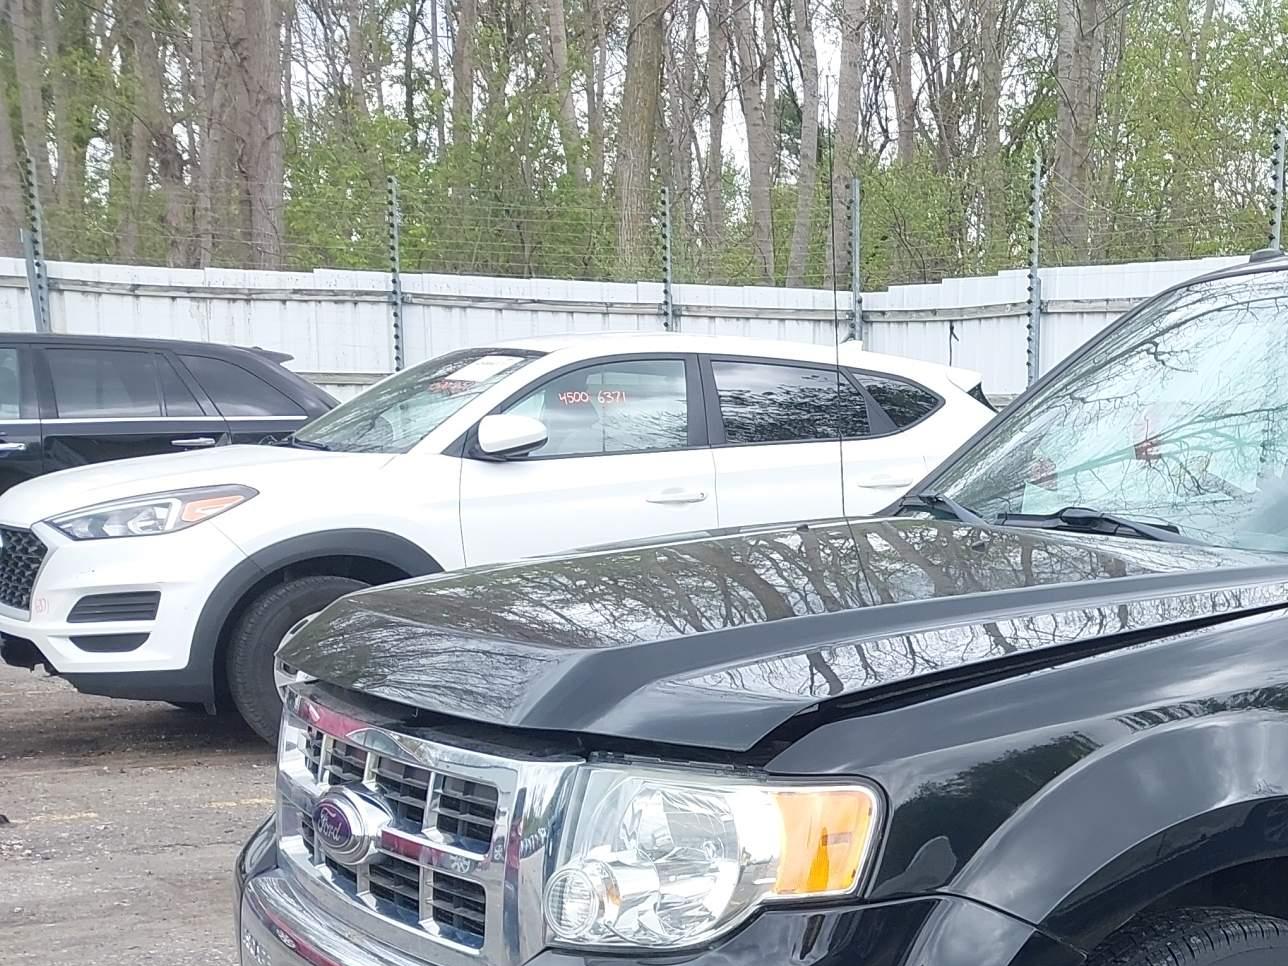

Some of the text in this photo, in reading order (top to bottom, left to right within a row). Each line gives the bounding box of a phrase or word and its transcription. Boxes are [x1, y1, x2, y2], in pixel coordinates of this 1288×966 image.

[558, 389, 627, 406] 4500 6371
[318, 806, 343, 842] Ford
